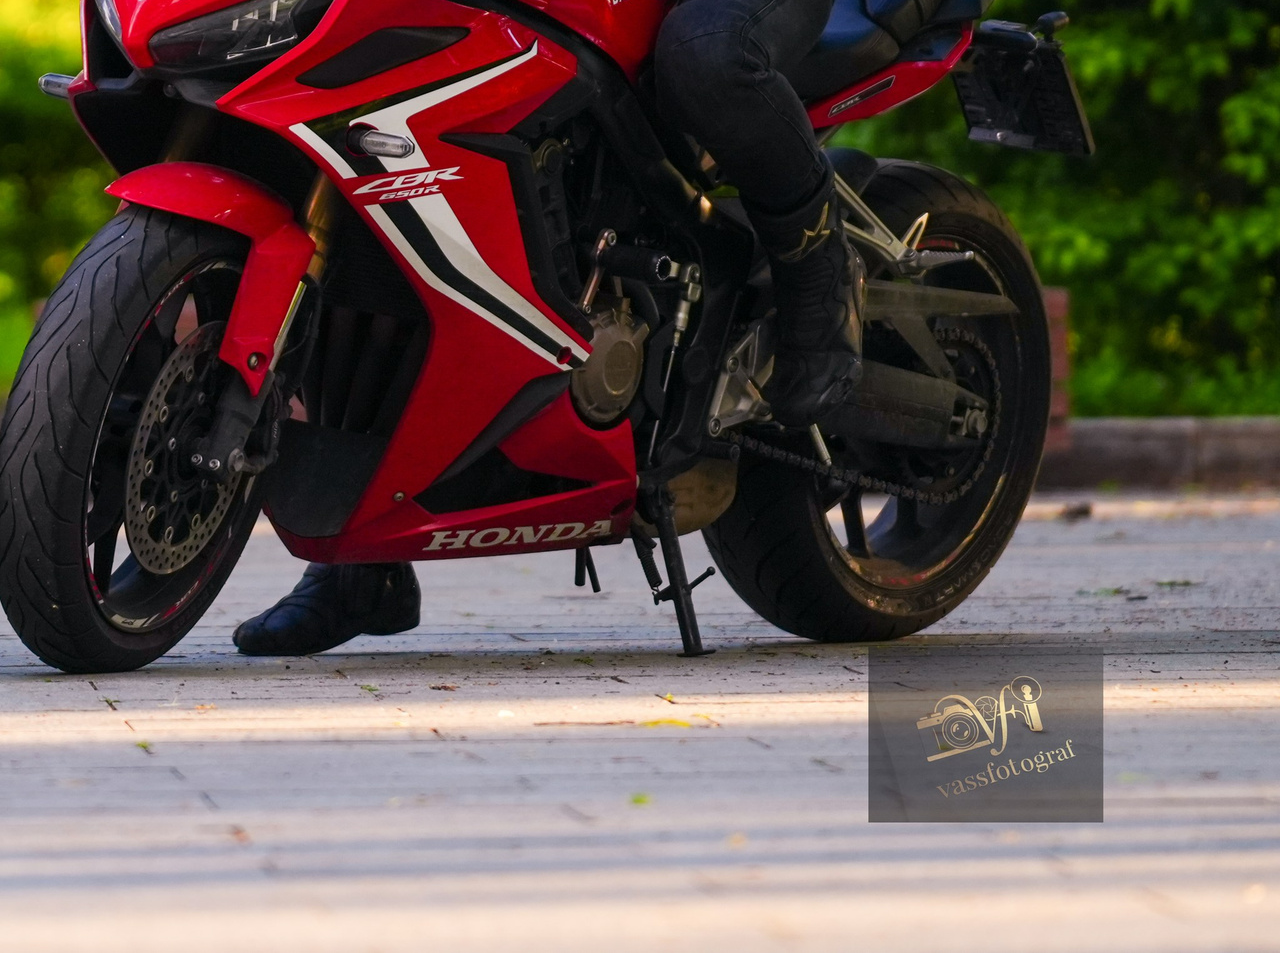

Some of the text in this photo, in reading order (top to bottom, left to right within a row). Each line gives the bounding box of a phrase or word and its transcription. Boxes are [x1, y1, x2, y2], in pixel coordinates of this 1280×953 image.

[352, 166, 464, 195] CBR
[378, 184, 441, 201] 650R
[422, 519, 612, 551] HONDA
